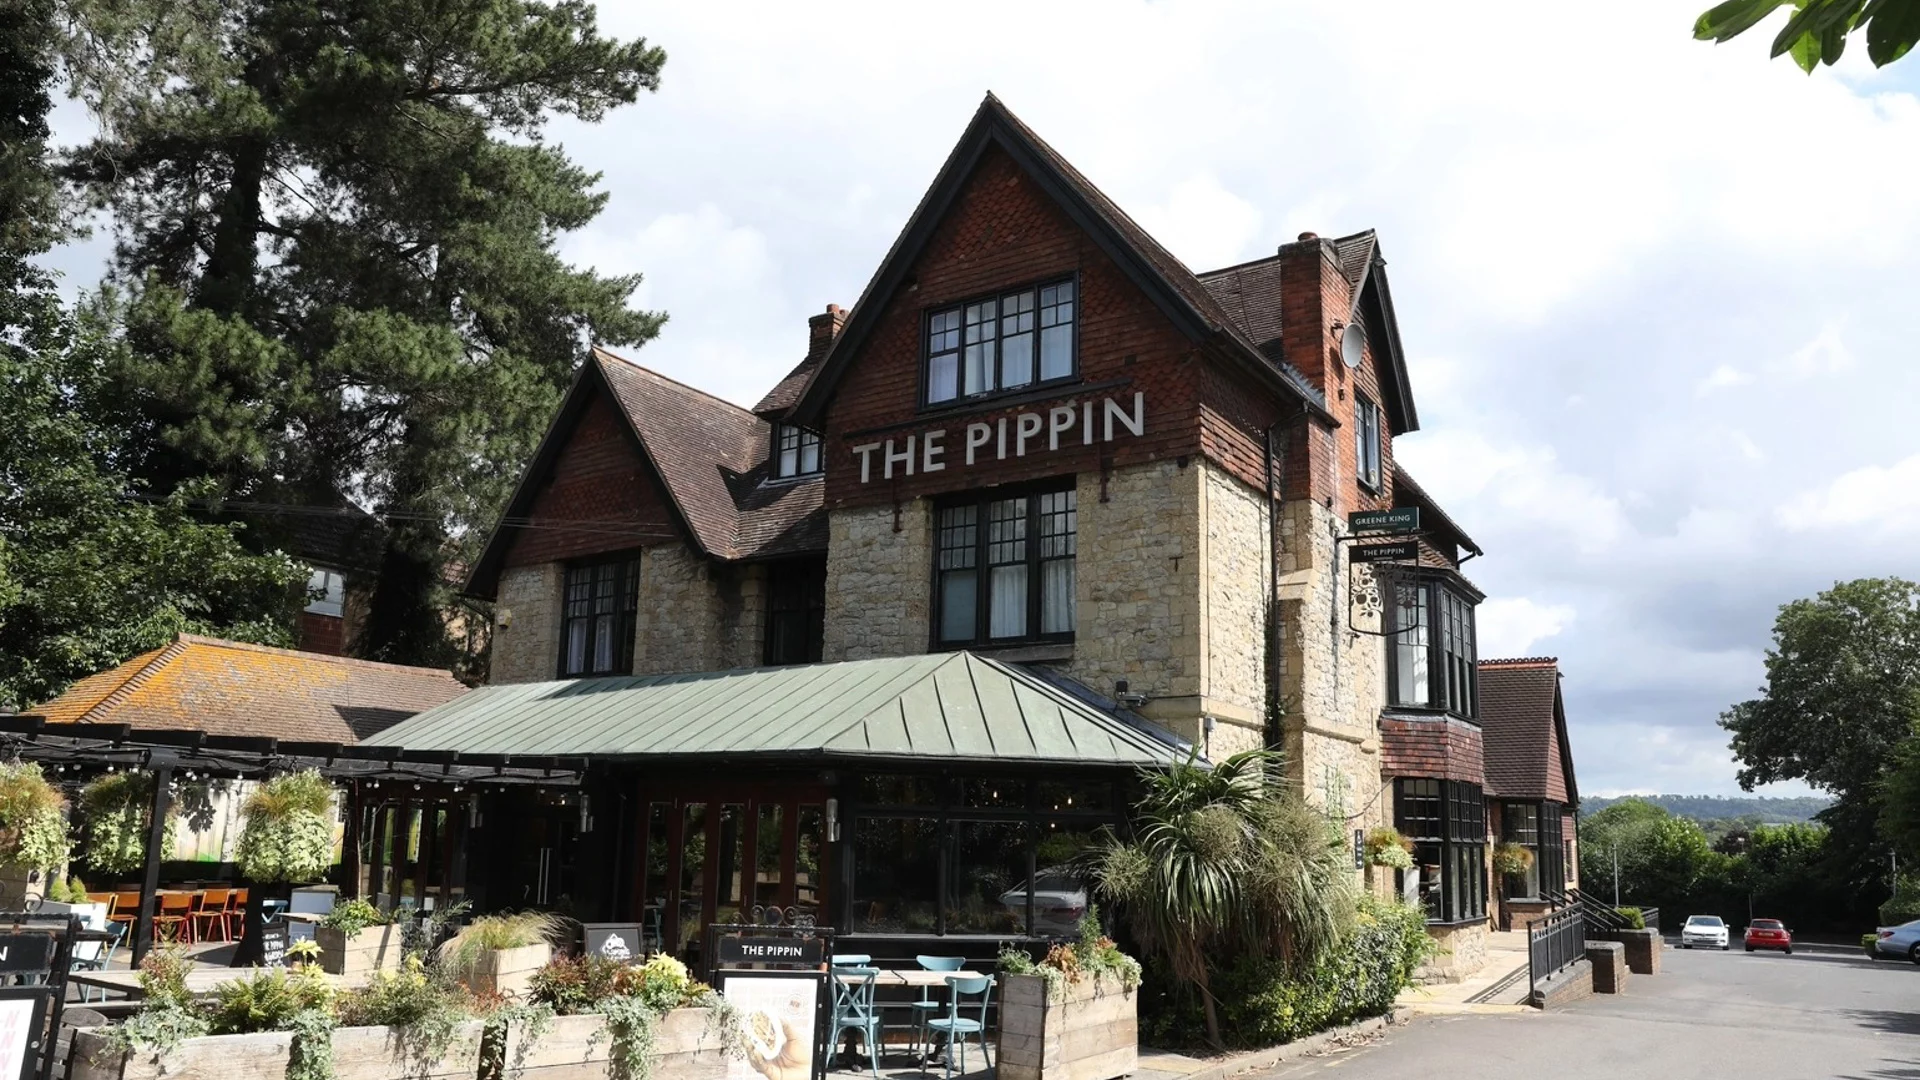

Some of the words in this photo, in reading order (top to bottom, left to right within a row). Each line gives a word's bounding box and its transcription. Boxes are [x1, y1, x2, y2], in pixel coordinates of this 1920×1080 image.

[852, 429, 946, 484] THE
[965, 391, 1145, 466] PIPPIN
[1355, 516, 1387, 525] GREENE
[741, 945, 764, 956] THE
[767, 946, 803, 957] PIPPIN
